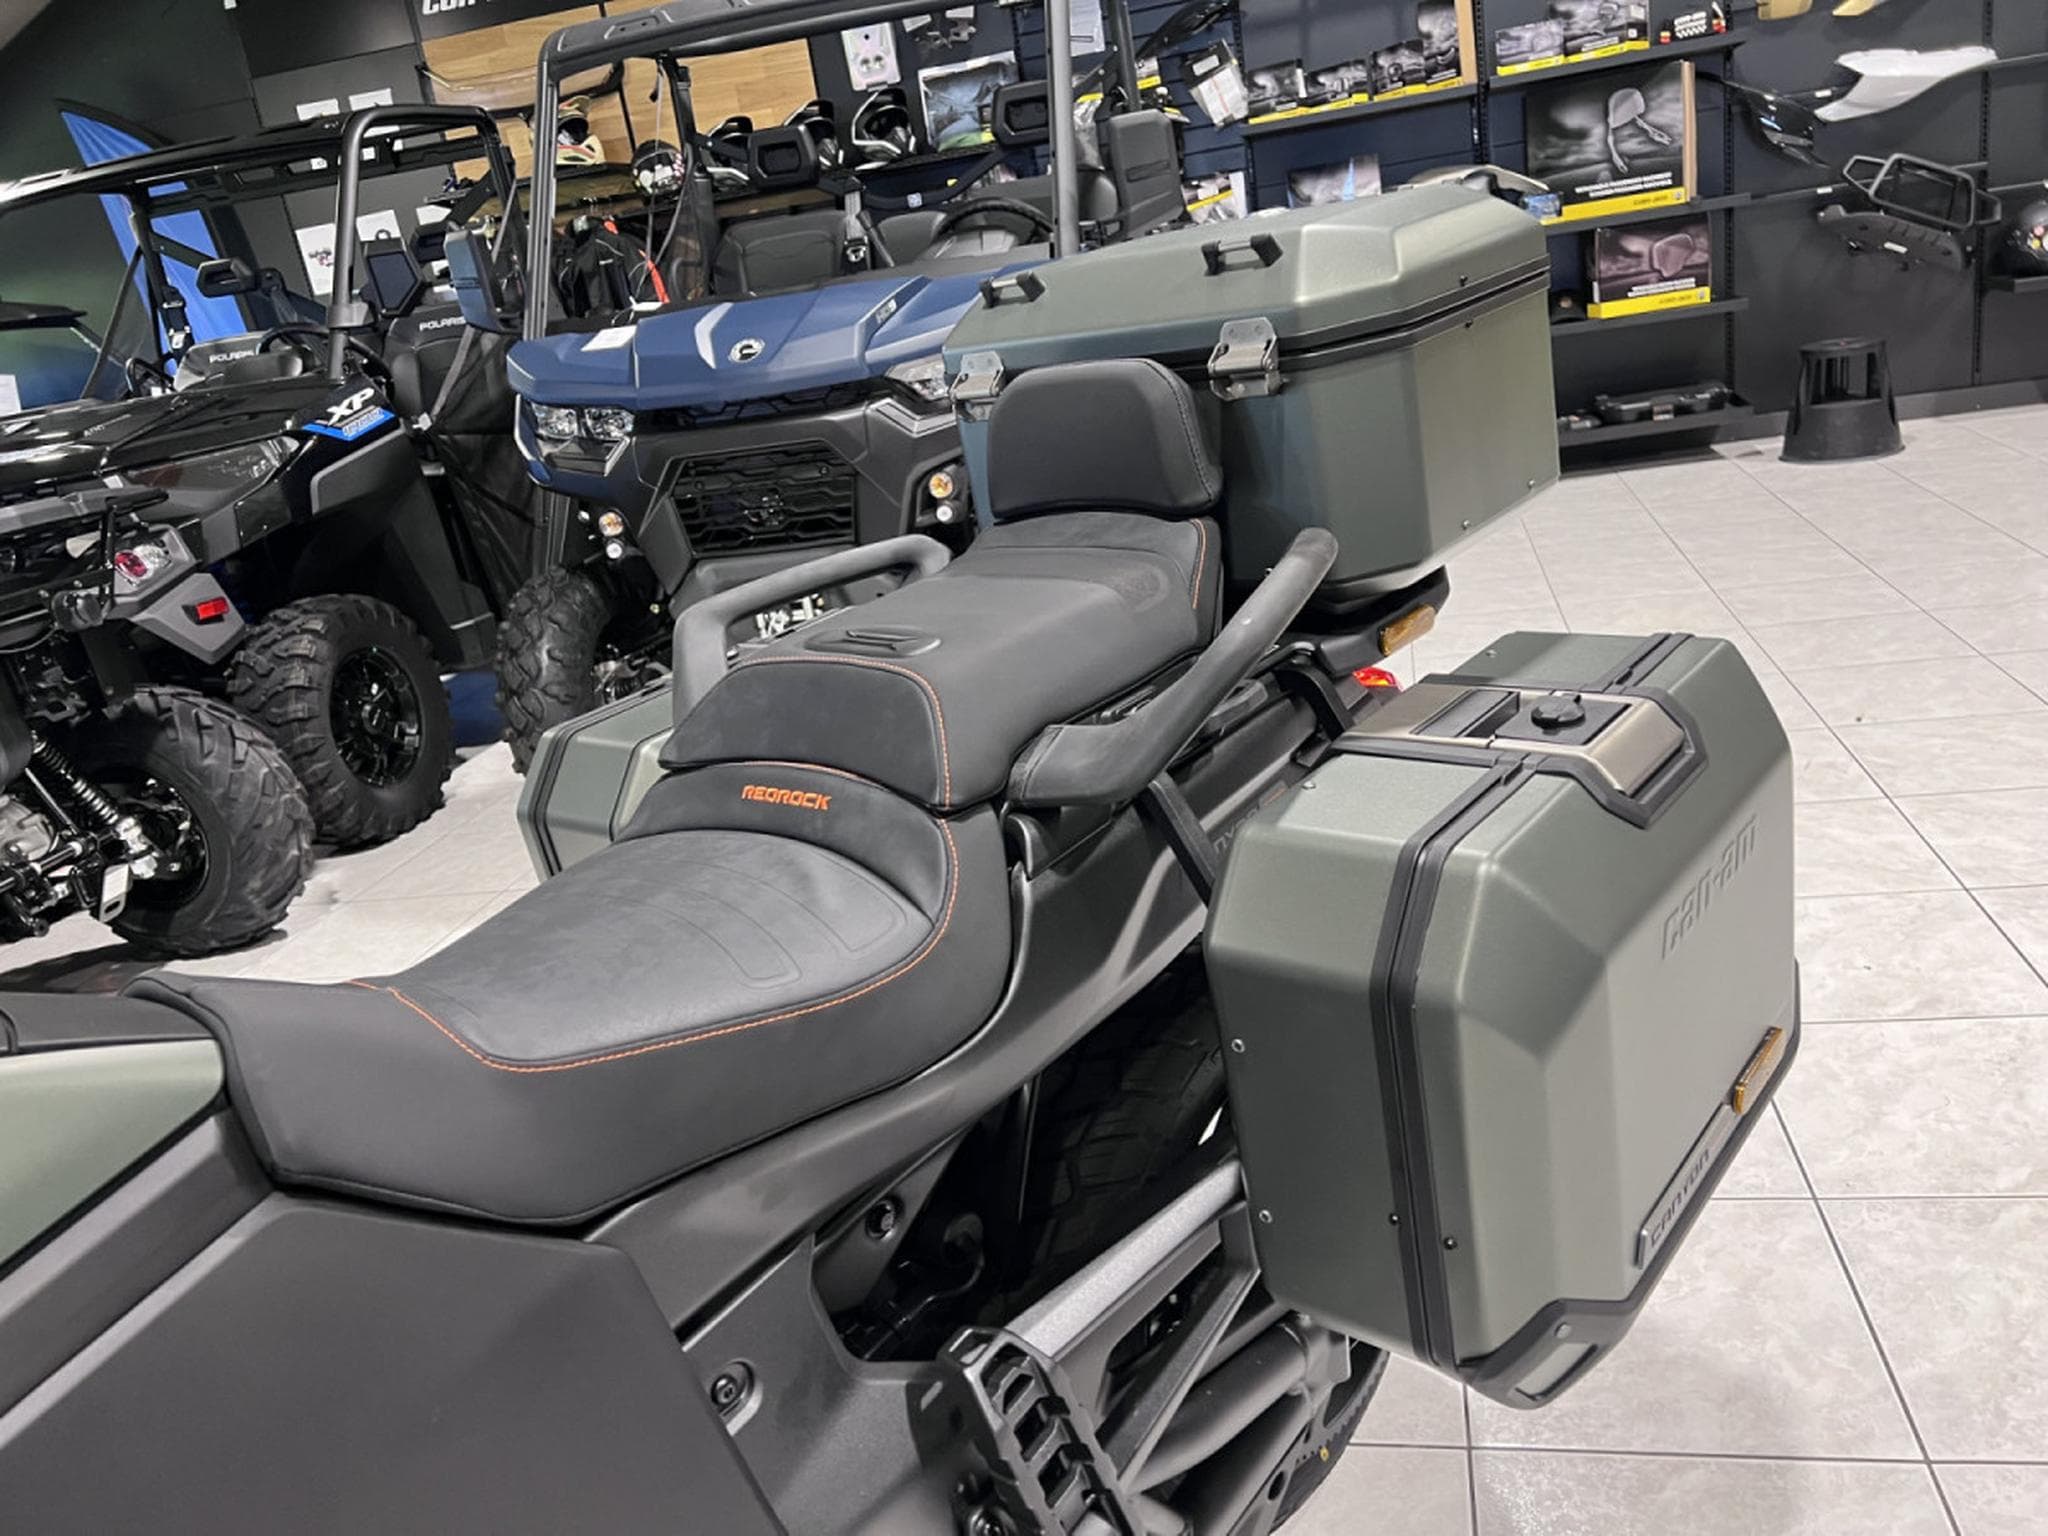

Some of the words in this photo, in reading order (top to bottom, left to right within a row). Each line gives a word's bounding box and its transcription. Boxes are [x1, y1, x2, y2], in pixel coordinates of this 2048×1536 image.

[326, 387, 375, 427] XP
[741, 784, 833, 811] REDROCK
[1650, 1148, 1710, 1248] CANYON
